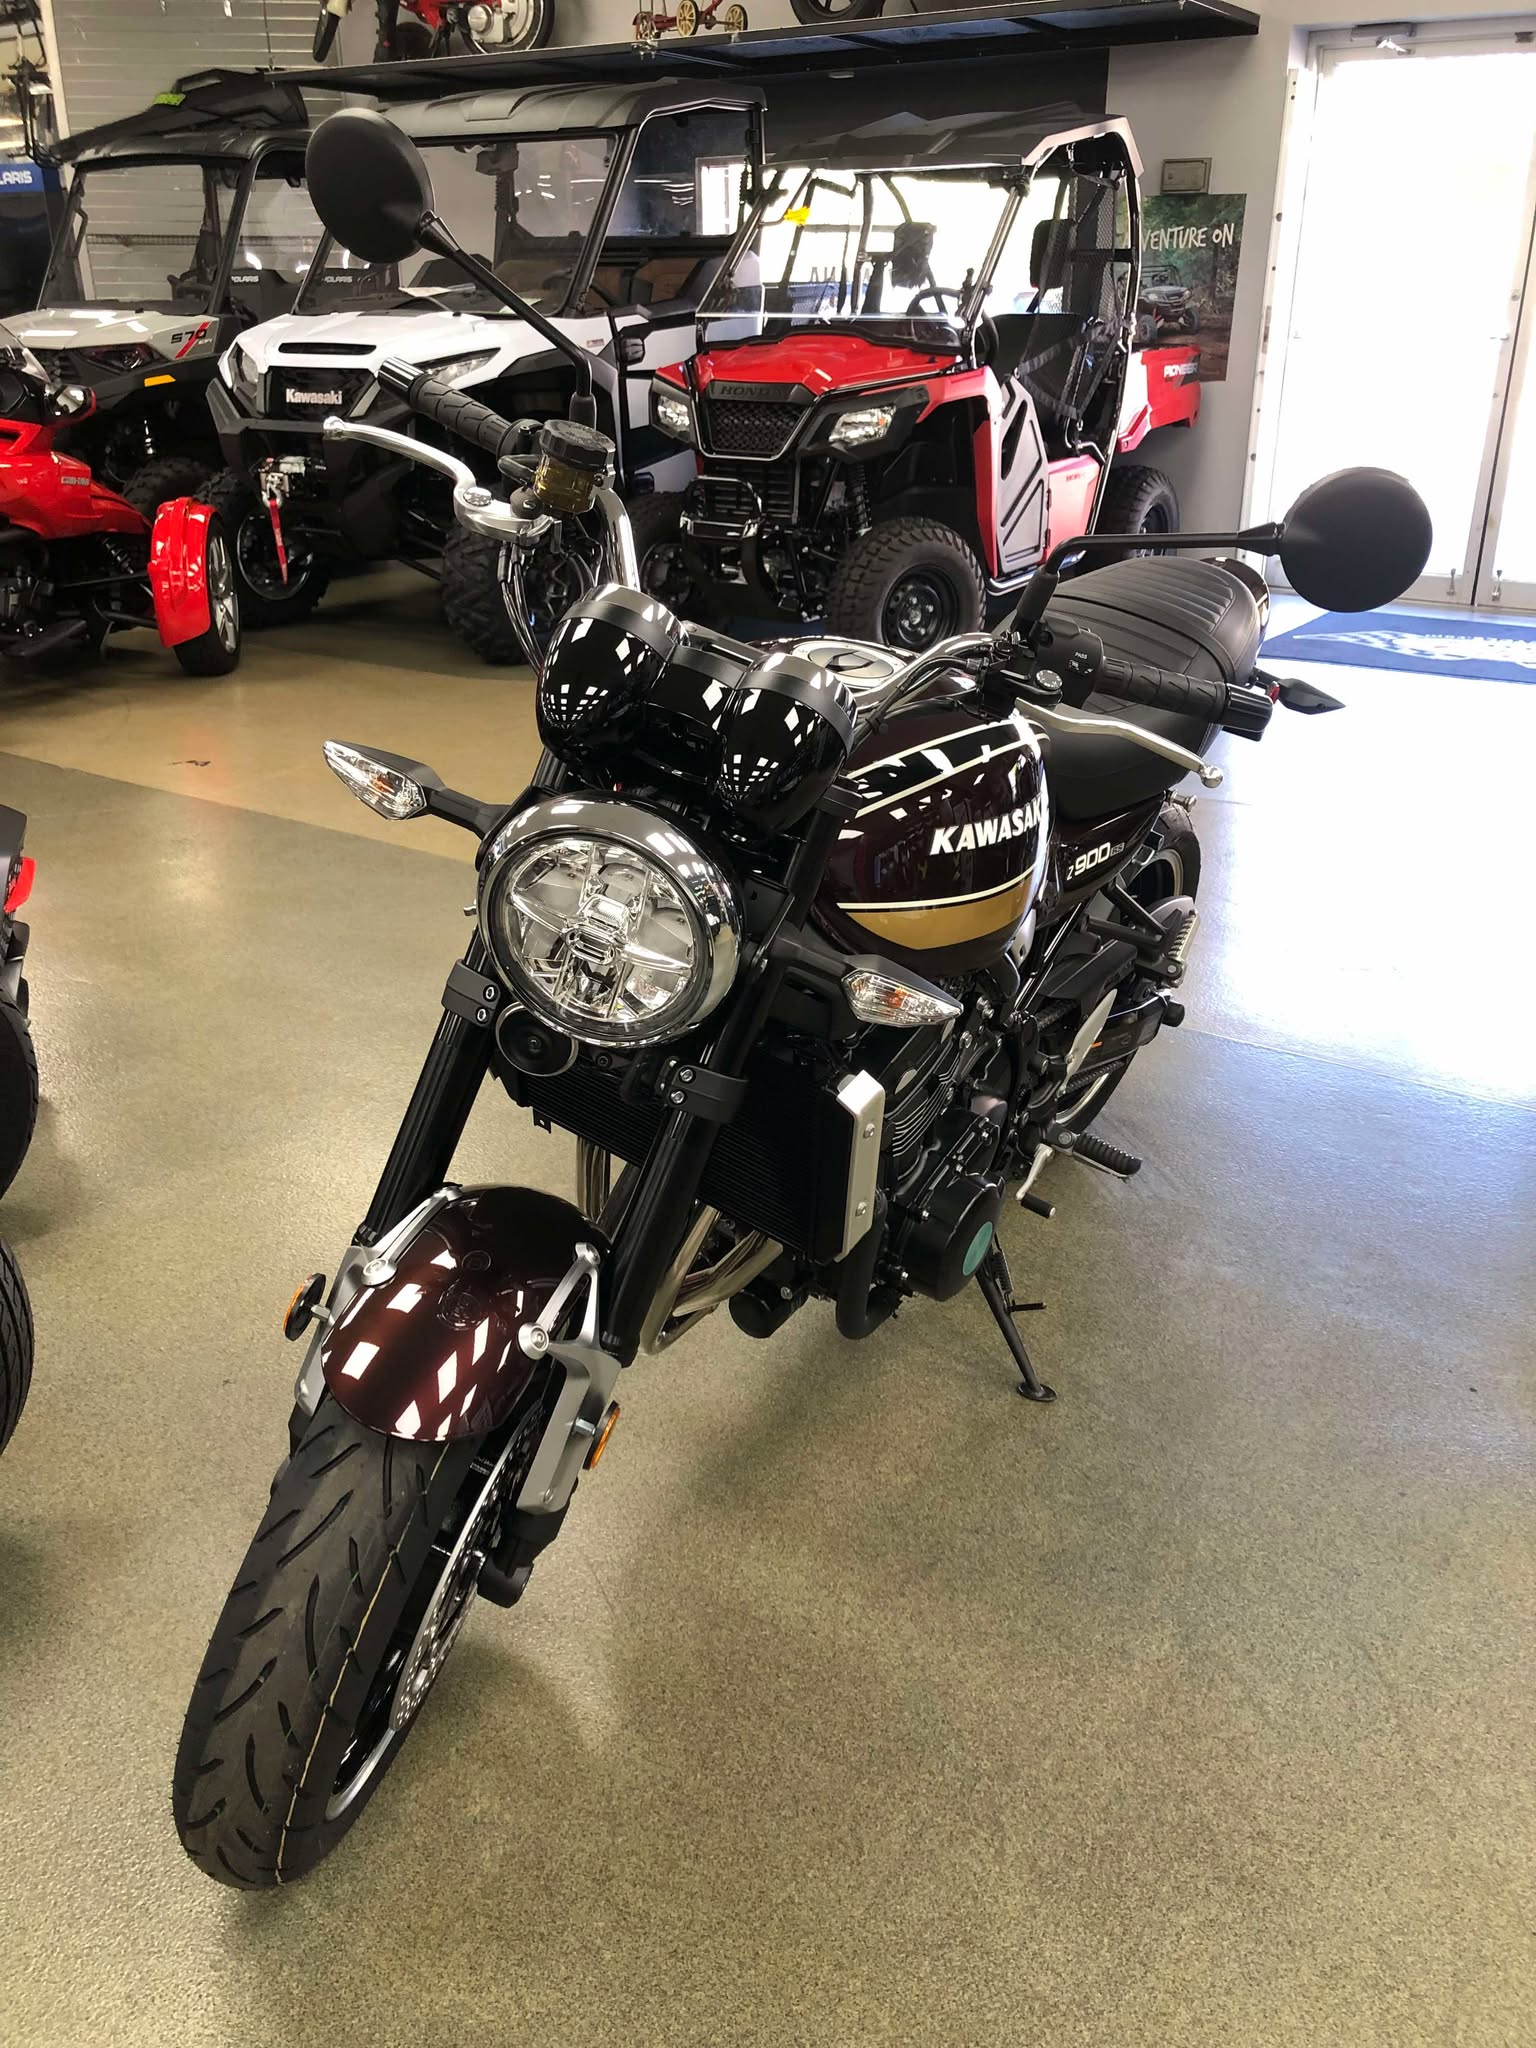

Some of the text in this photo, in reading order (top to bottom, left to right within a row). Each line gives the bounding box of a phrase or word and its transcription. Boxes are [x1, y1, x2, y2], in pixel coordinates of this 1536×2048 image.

[1138, 223, 1235, 252] VENTURE ON
[286, 388, 343, 405] Kawasaki
[929, 796, 1043, 856] KAWASAK
